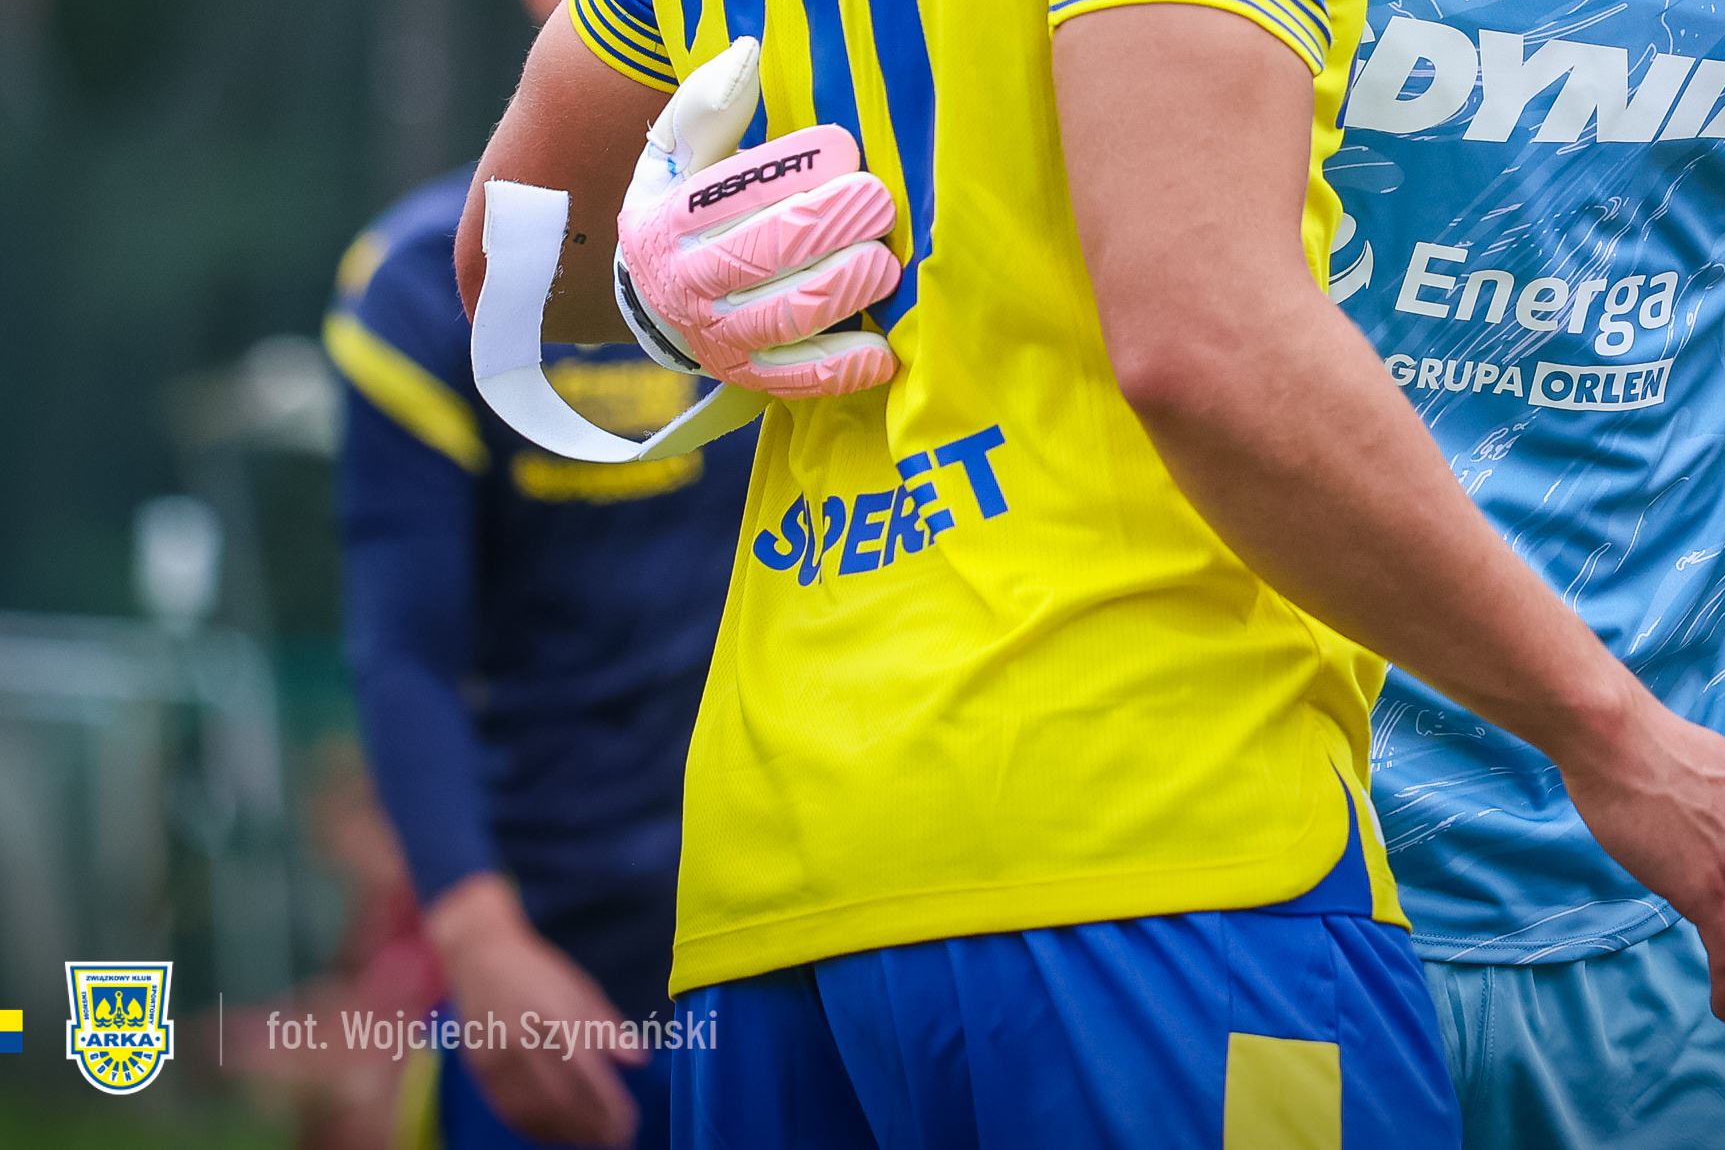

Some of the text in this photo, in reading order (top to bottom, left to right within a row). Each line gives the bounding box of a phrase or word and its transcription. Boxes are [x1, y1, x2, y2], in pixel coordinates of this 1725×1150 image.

[1394, 241, 1679, 357] Energa
[1384, 353, 1665, 404] GRUPA ORLEN
